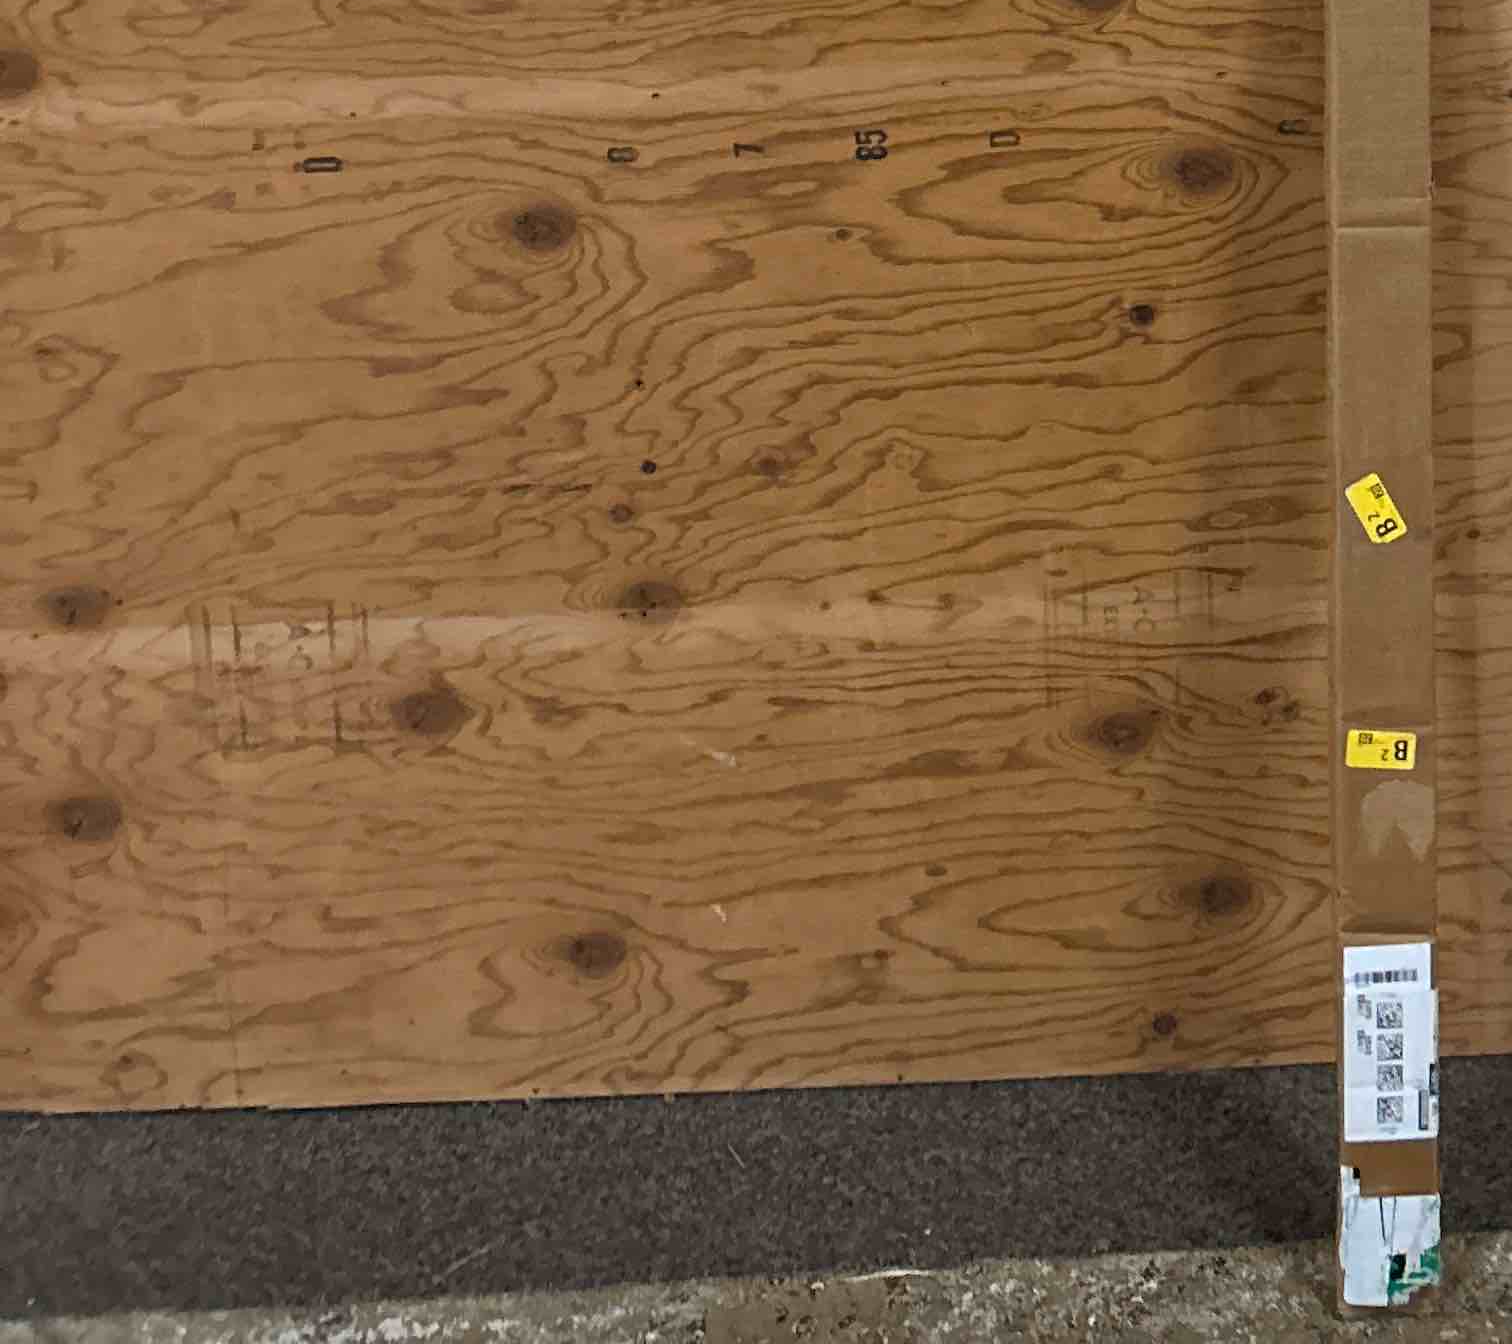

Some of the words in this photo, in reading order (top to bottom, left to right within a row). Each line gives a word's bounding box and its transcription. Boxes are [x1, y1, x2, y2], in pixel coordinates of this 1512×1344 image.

[853, 129, 888, 161] 85
[1375, 517, 1398, 539] B
[1393, 739, 1408, 761] B
